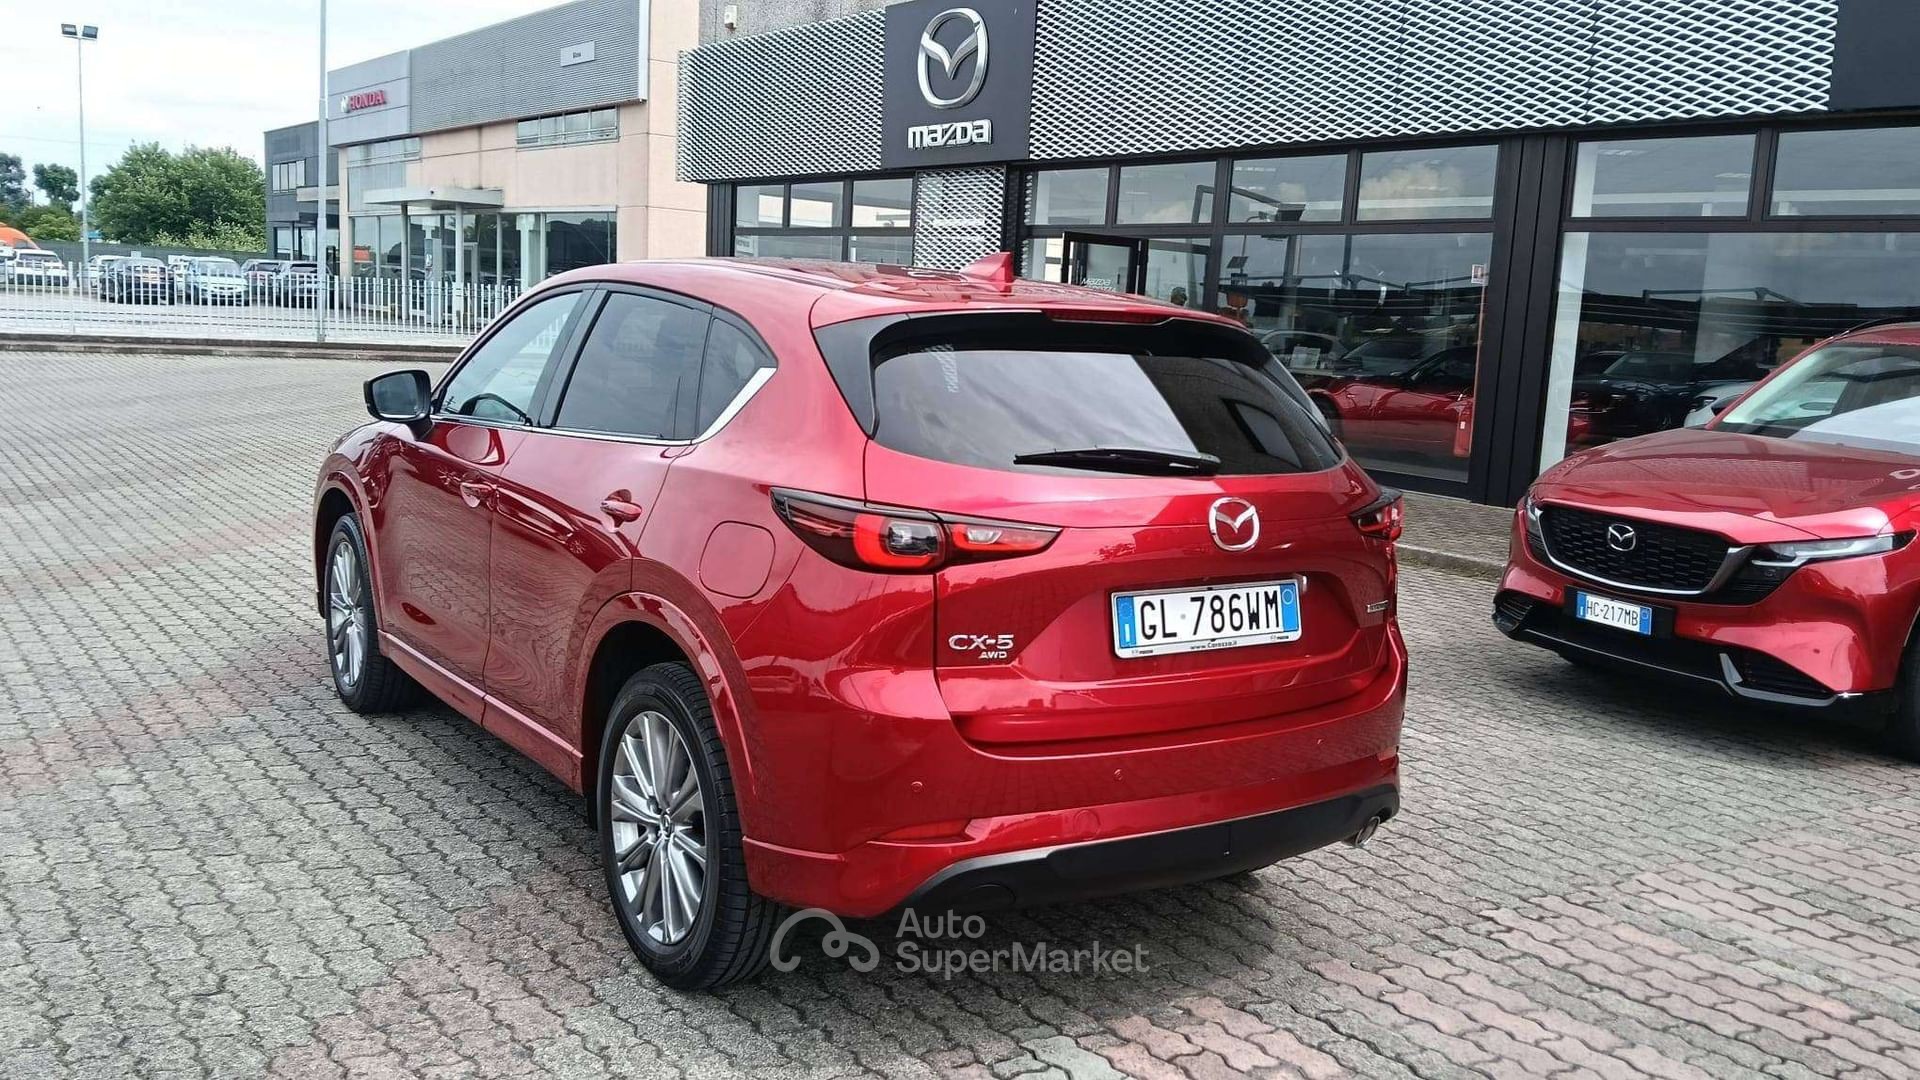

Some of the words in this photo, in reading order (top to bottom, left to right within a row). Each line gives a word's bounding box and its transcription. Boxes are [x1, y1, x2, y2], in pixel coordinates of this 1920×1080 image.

[350, 89, 386, 111] HONDA
[1140, 599, 1178, 641] GL
[1189, 589, 1281, 636] 786WM
[947, 633, 1015, 650] CX-5
[978, 650, 1009, 659] AWD
